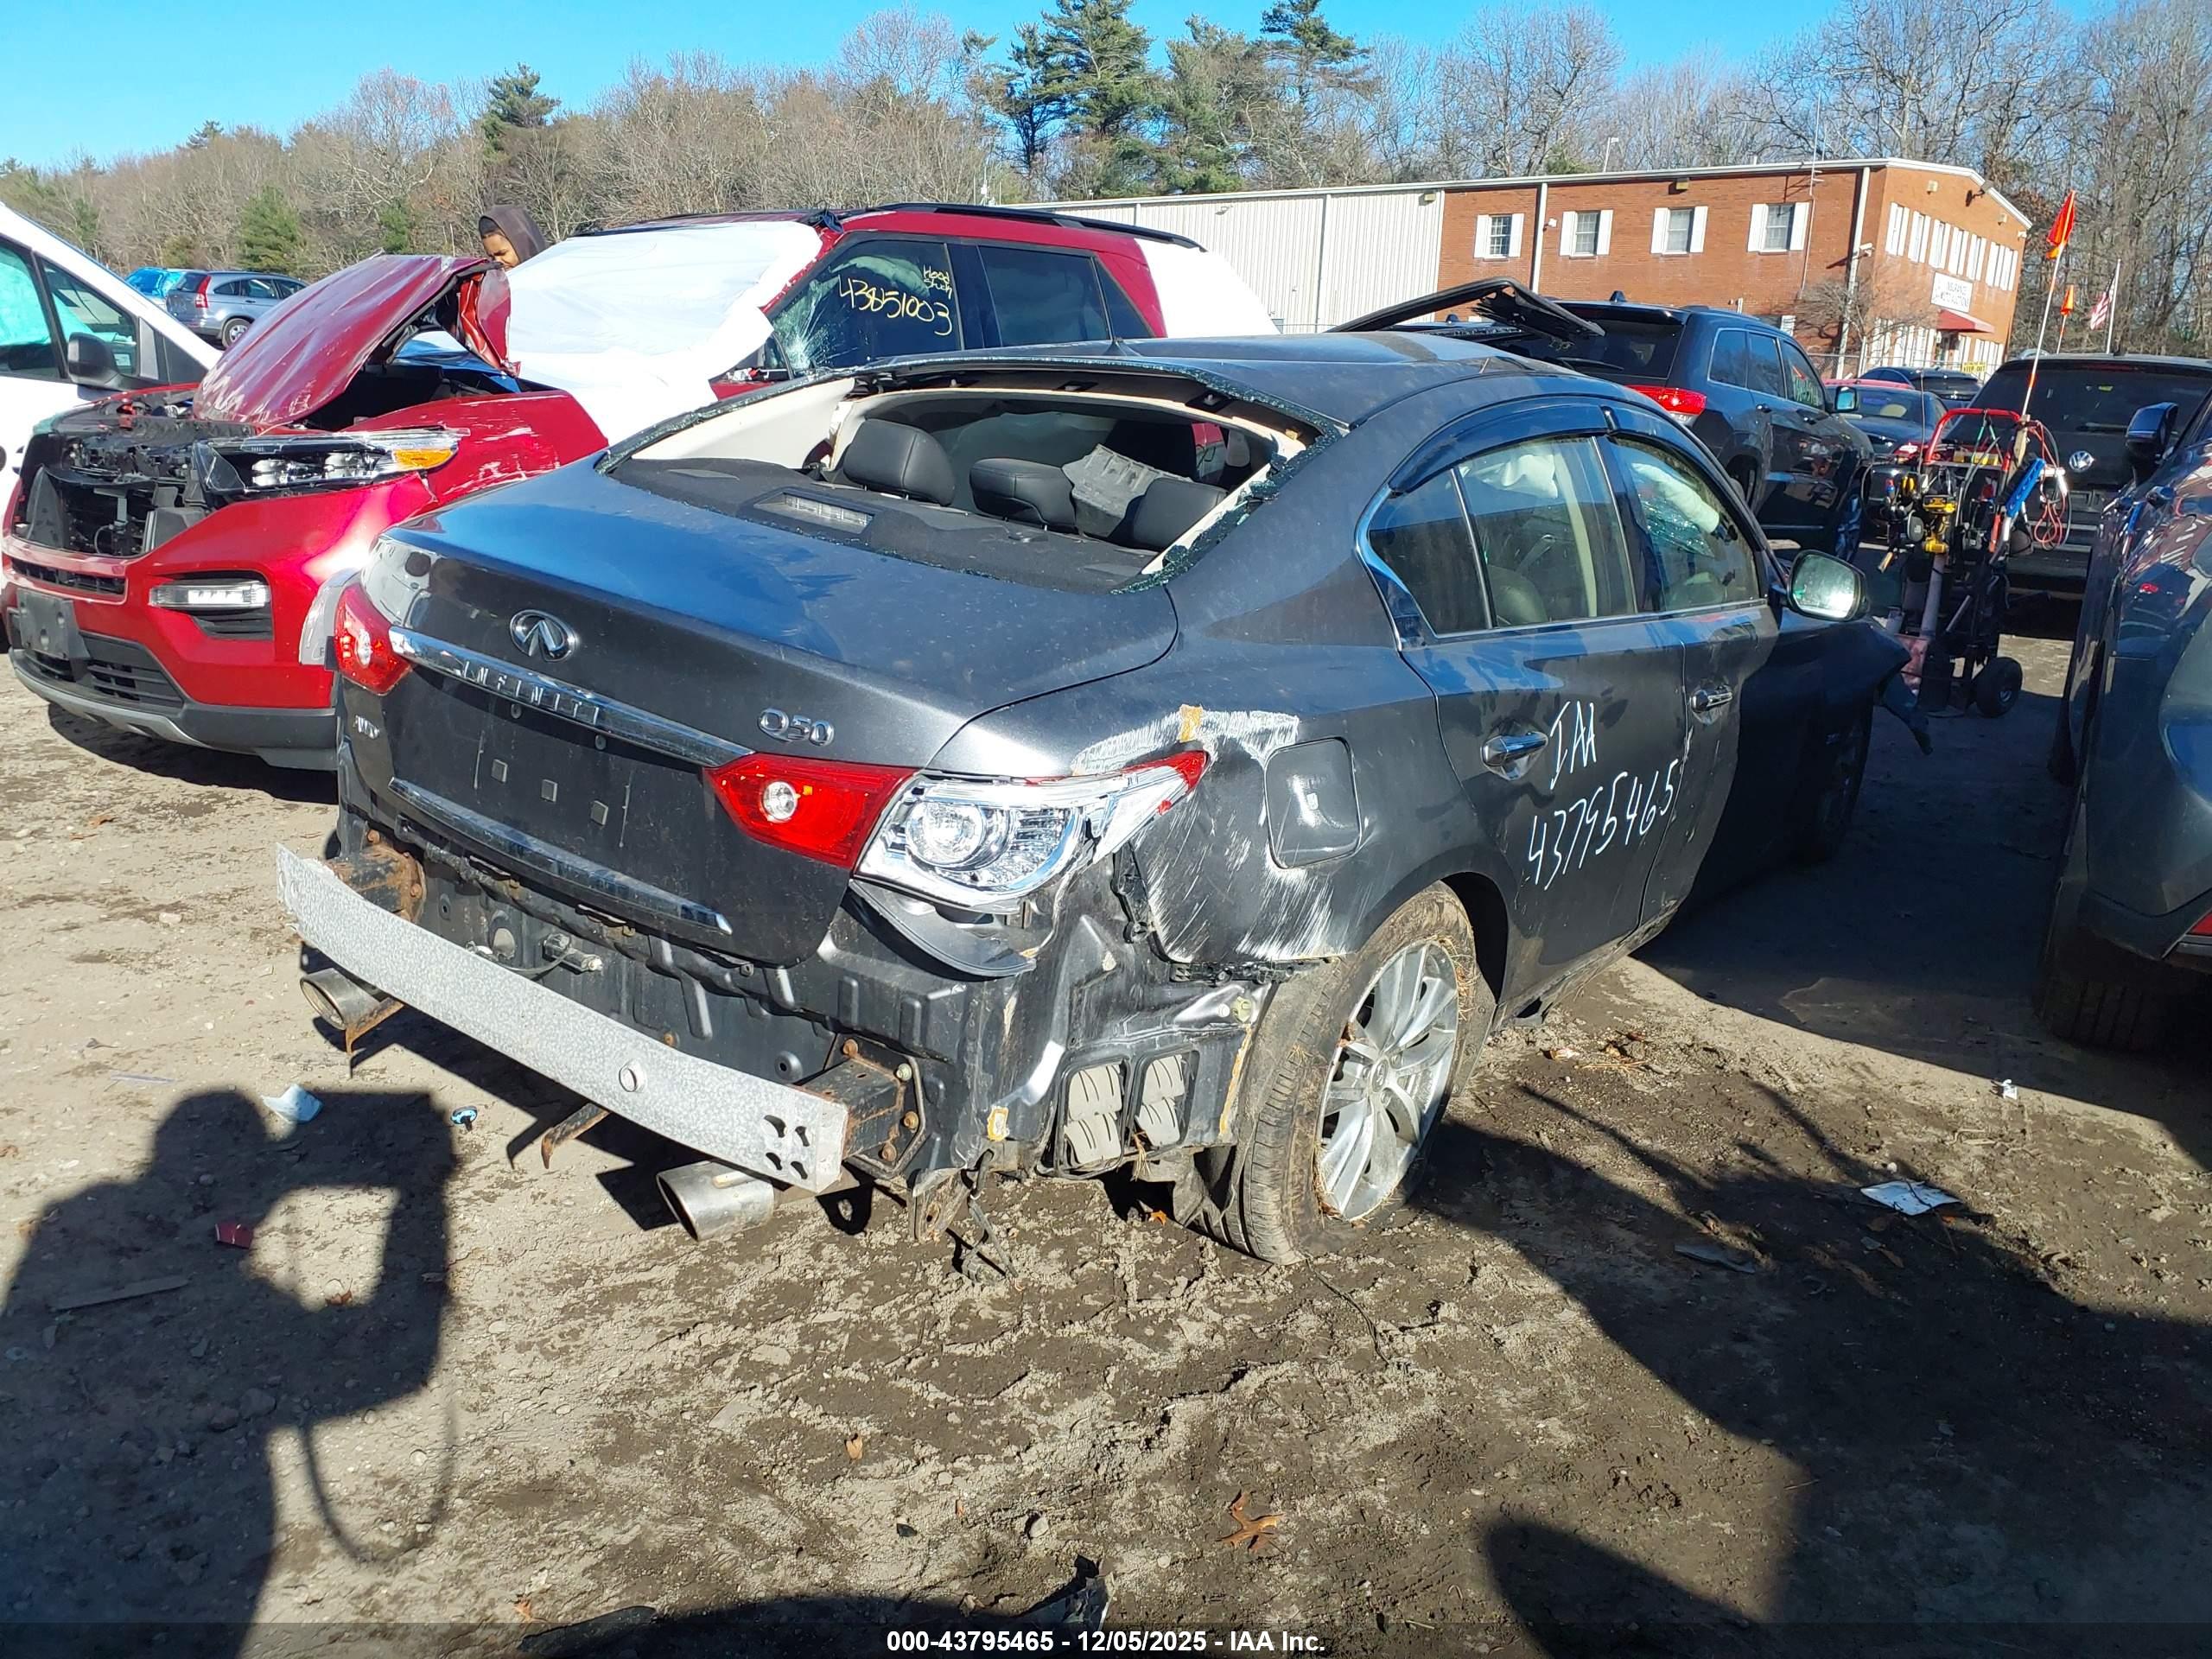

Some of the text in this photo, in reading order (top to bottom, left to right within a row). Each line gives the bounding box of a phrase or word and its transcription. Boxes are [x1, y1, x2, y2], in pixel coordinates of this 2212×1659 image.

[837, 274, 953, 336] 43851003
[462, 660, 601, 726] INFINITI
[757, 708, 836, 747] Q50
[1549, 700, 1597, 791] IAA
[1528, 758, 1680, 892] 43795465
